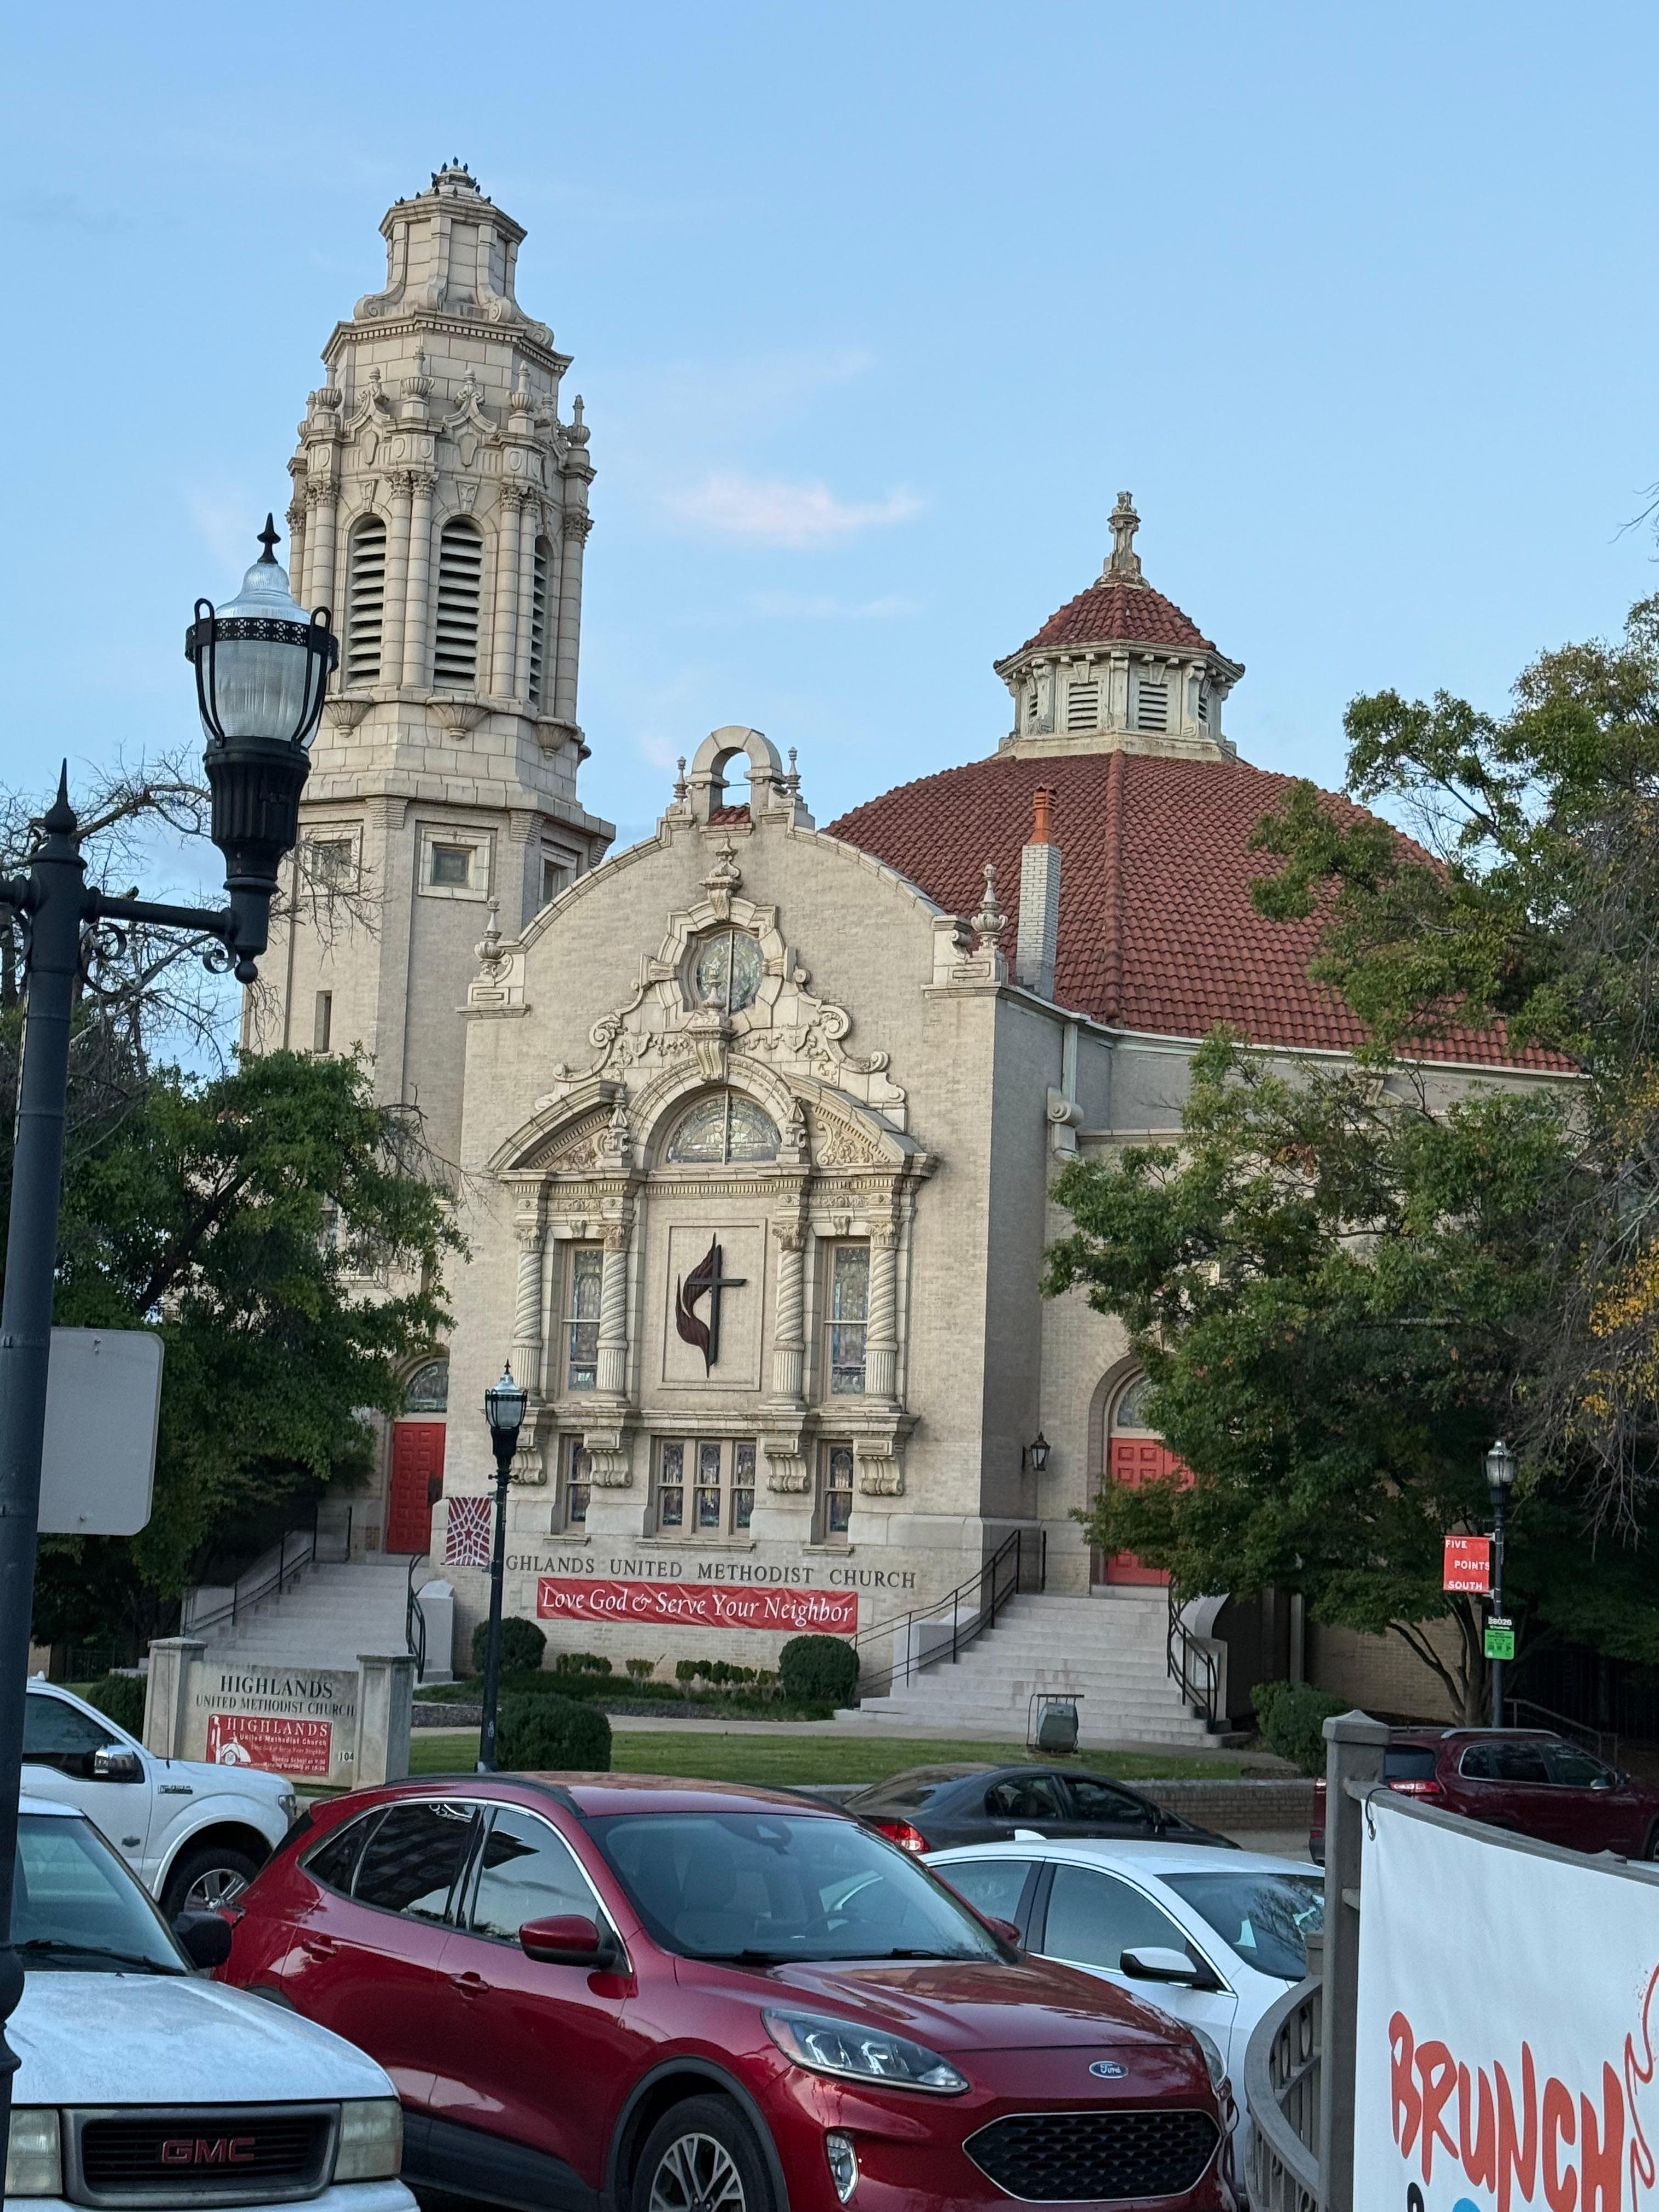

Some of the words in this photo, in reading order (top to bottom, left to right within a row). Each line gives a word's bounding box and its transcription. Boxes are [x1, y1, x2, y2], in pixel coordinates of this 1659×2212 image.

[1445, 1539, 1468, 1549] FIVE
[506, 1555, 595, 1573] GHLANDS
[610, 1558, 682, 1578] UNITED
[697, 1562, 814, 1584] METHODIST
[830, 1569, 916, 1589] CHURCH
[1454, 1560, 1490, 1571] POINTS
[1447, 1581, 1483, 1590] SOUTH
[541, 1587, 584, 1609] Love
[590, 1588, 628, 1611] God
[632, 1593, 652, 1612] &
[656, 1592, 706, 1615] Serve
[712, 1594, 760, 1618] Your
[764, 1596, 854, 1627] Neighbor
[221, 1675, 332, 1699] HIGHLANDS
[196, 1694, 236, 1709] UNITED
[240, 1697, 304, 1714] METHODIST
[308, 1702, 355, 1717] CHURCH
[226, 1717, 328, 1737] HIGHLANDS
[1389, 2011, 1625, 2212] BRUNCH
[162, 2137, 256, 2164] GMC
